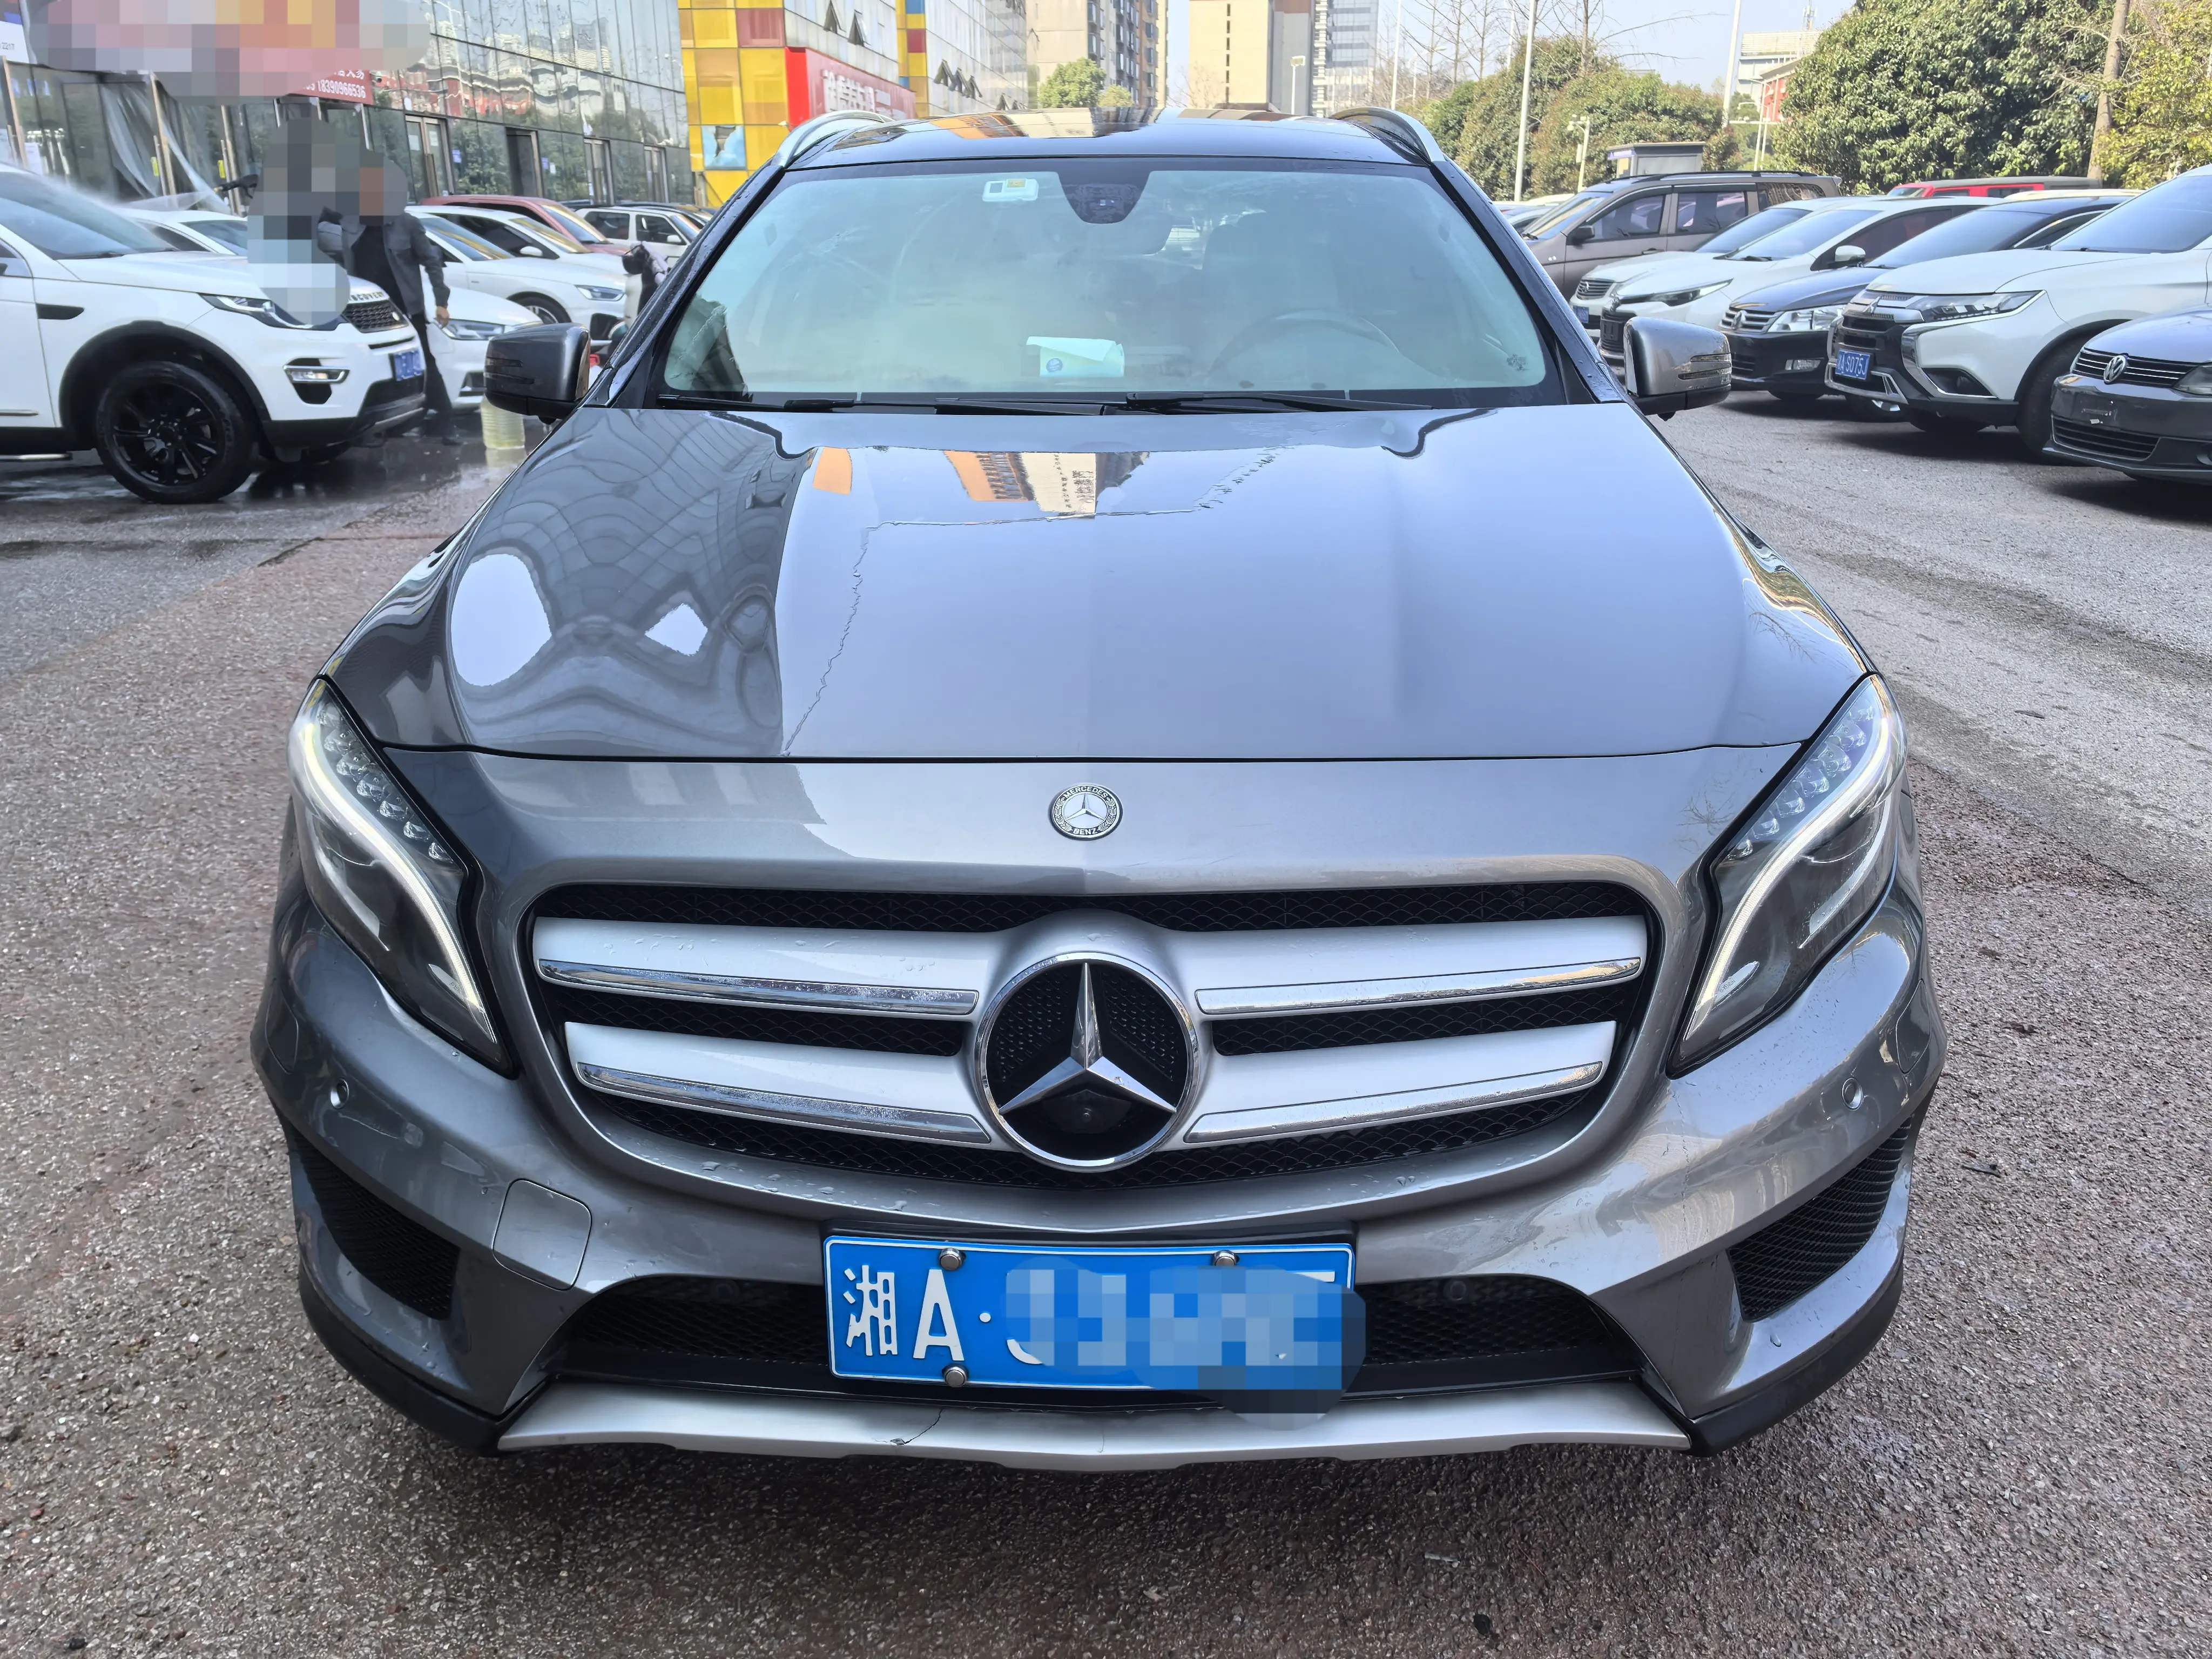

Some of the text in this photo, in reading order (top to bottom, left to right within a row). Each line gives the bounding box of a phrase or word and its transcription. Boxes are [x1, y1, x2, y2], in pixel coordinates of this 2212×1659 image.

[318, 79, 366, 98] 18390966536
[1063, 786, 1108, 799] MERCEDES
[1073, 827, 1098, 835] BENZ
